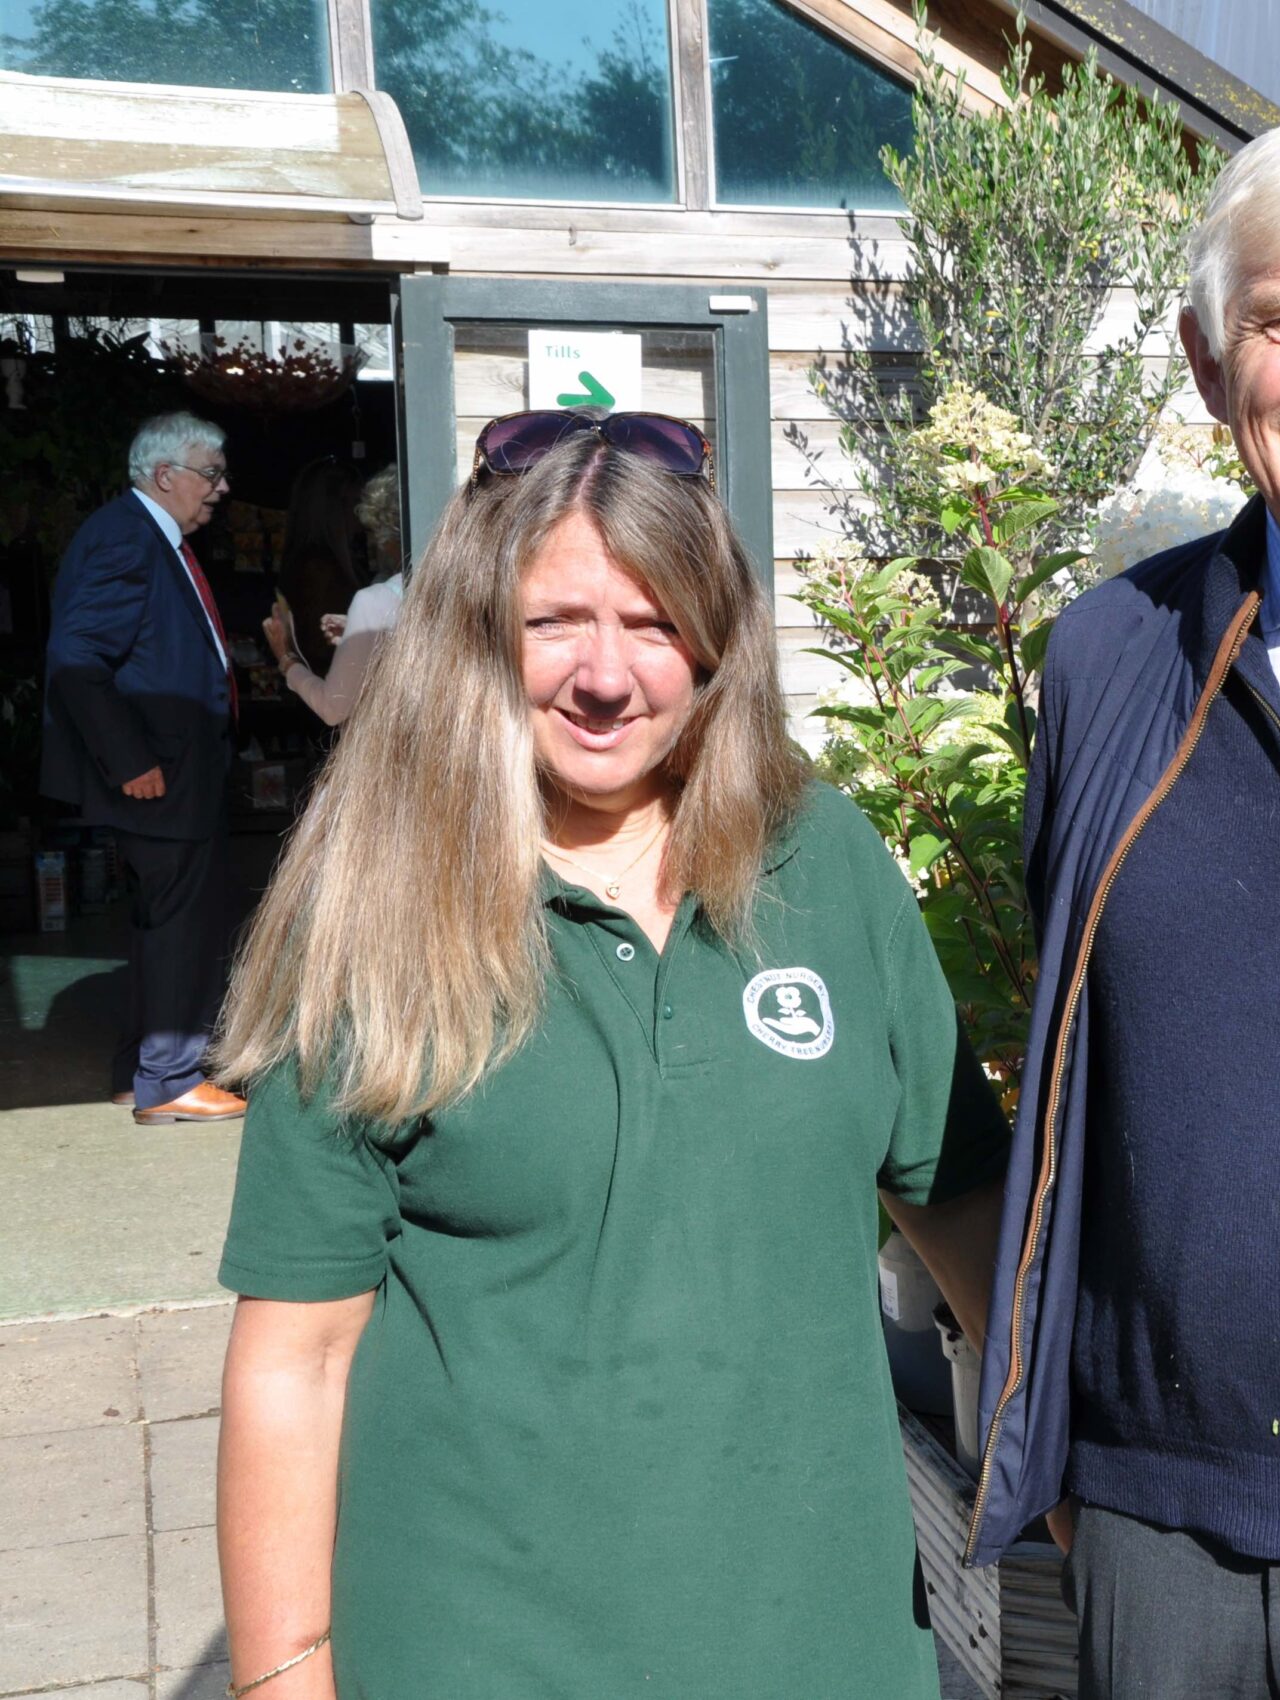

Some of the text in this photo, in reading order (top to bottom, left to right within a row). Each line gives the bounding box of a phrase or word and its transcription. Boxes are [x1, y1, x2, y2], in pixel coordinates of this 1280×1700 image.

[545, 345, 581, 359] Tills
[752, 1023, 787, 1050] CHERRY
[791, 1046, 815, 1055] TREE
